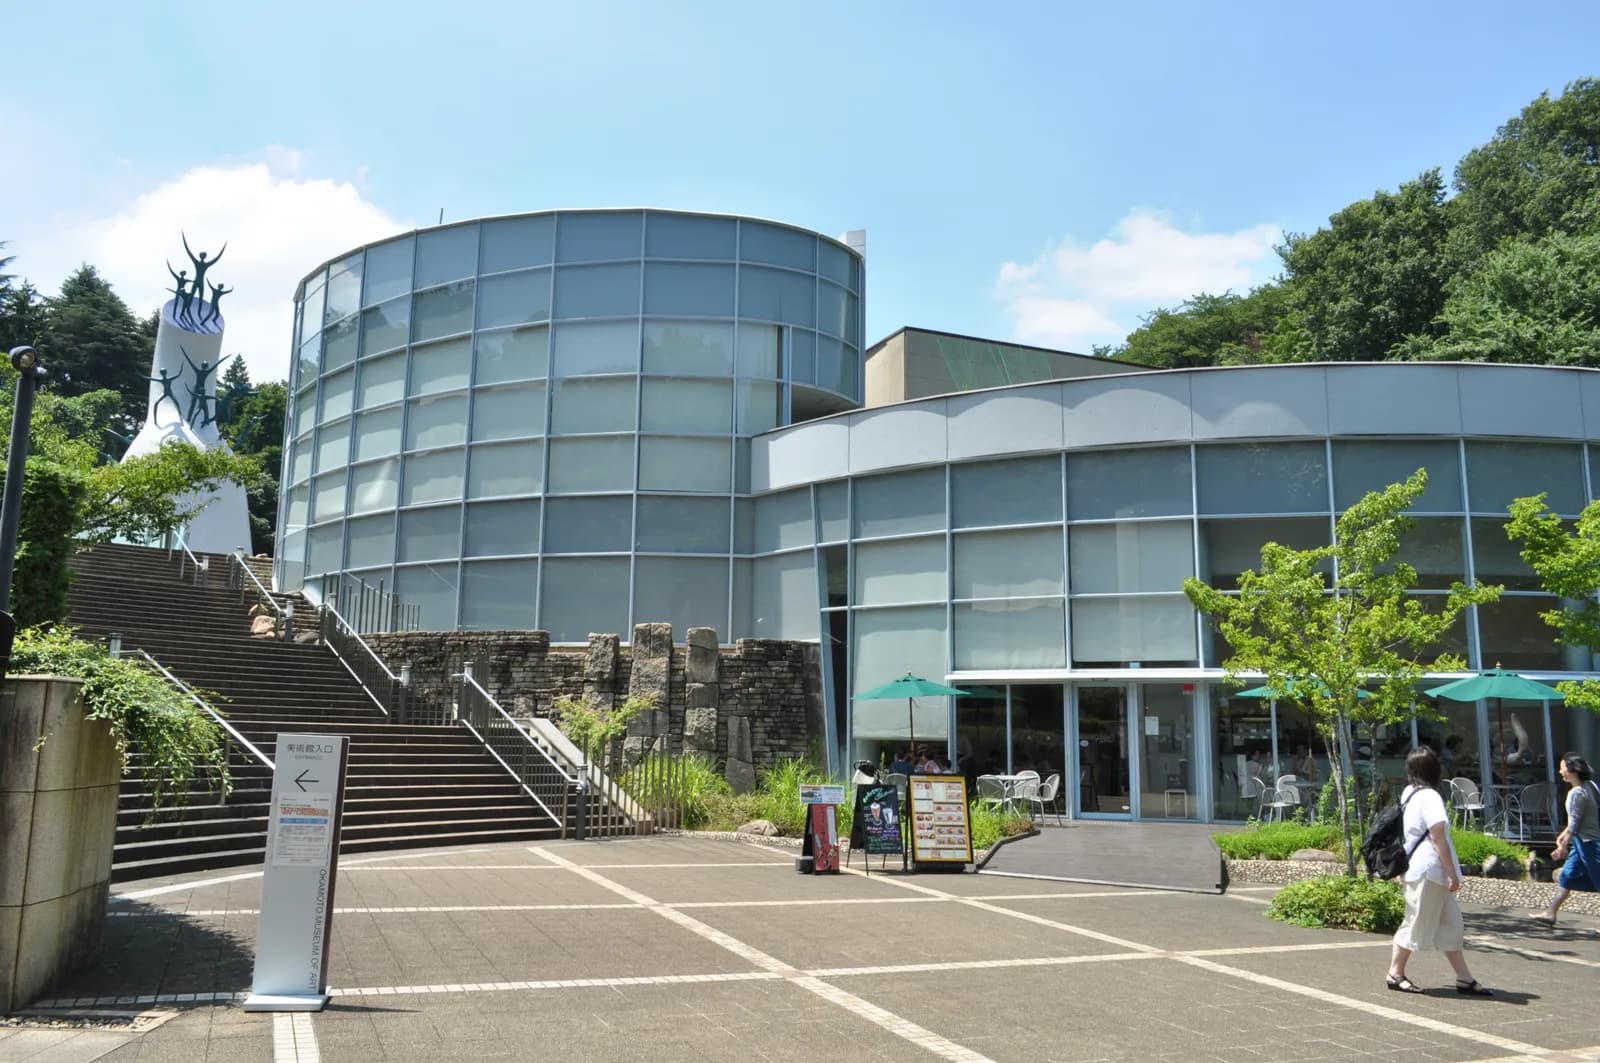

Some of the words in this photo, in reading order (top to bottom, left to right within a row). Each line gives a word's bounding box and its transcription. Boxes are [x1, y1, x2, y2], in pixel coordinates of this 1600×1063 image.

[287, 743, 333, 753] 美術館入口
[315, 869, 327, 914] OKAMOTO
[312, 915, 323, 956] MUSEUM
[310, 957, 319, 969] OF
[308, 972, 317, 992] ART
